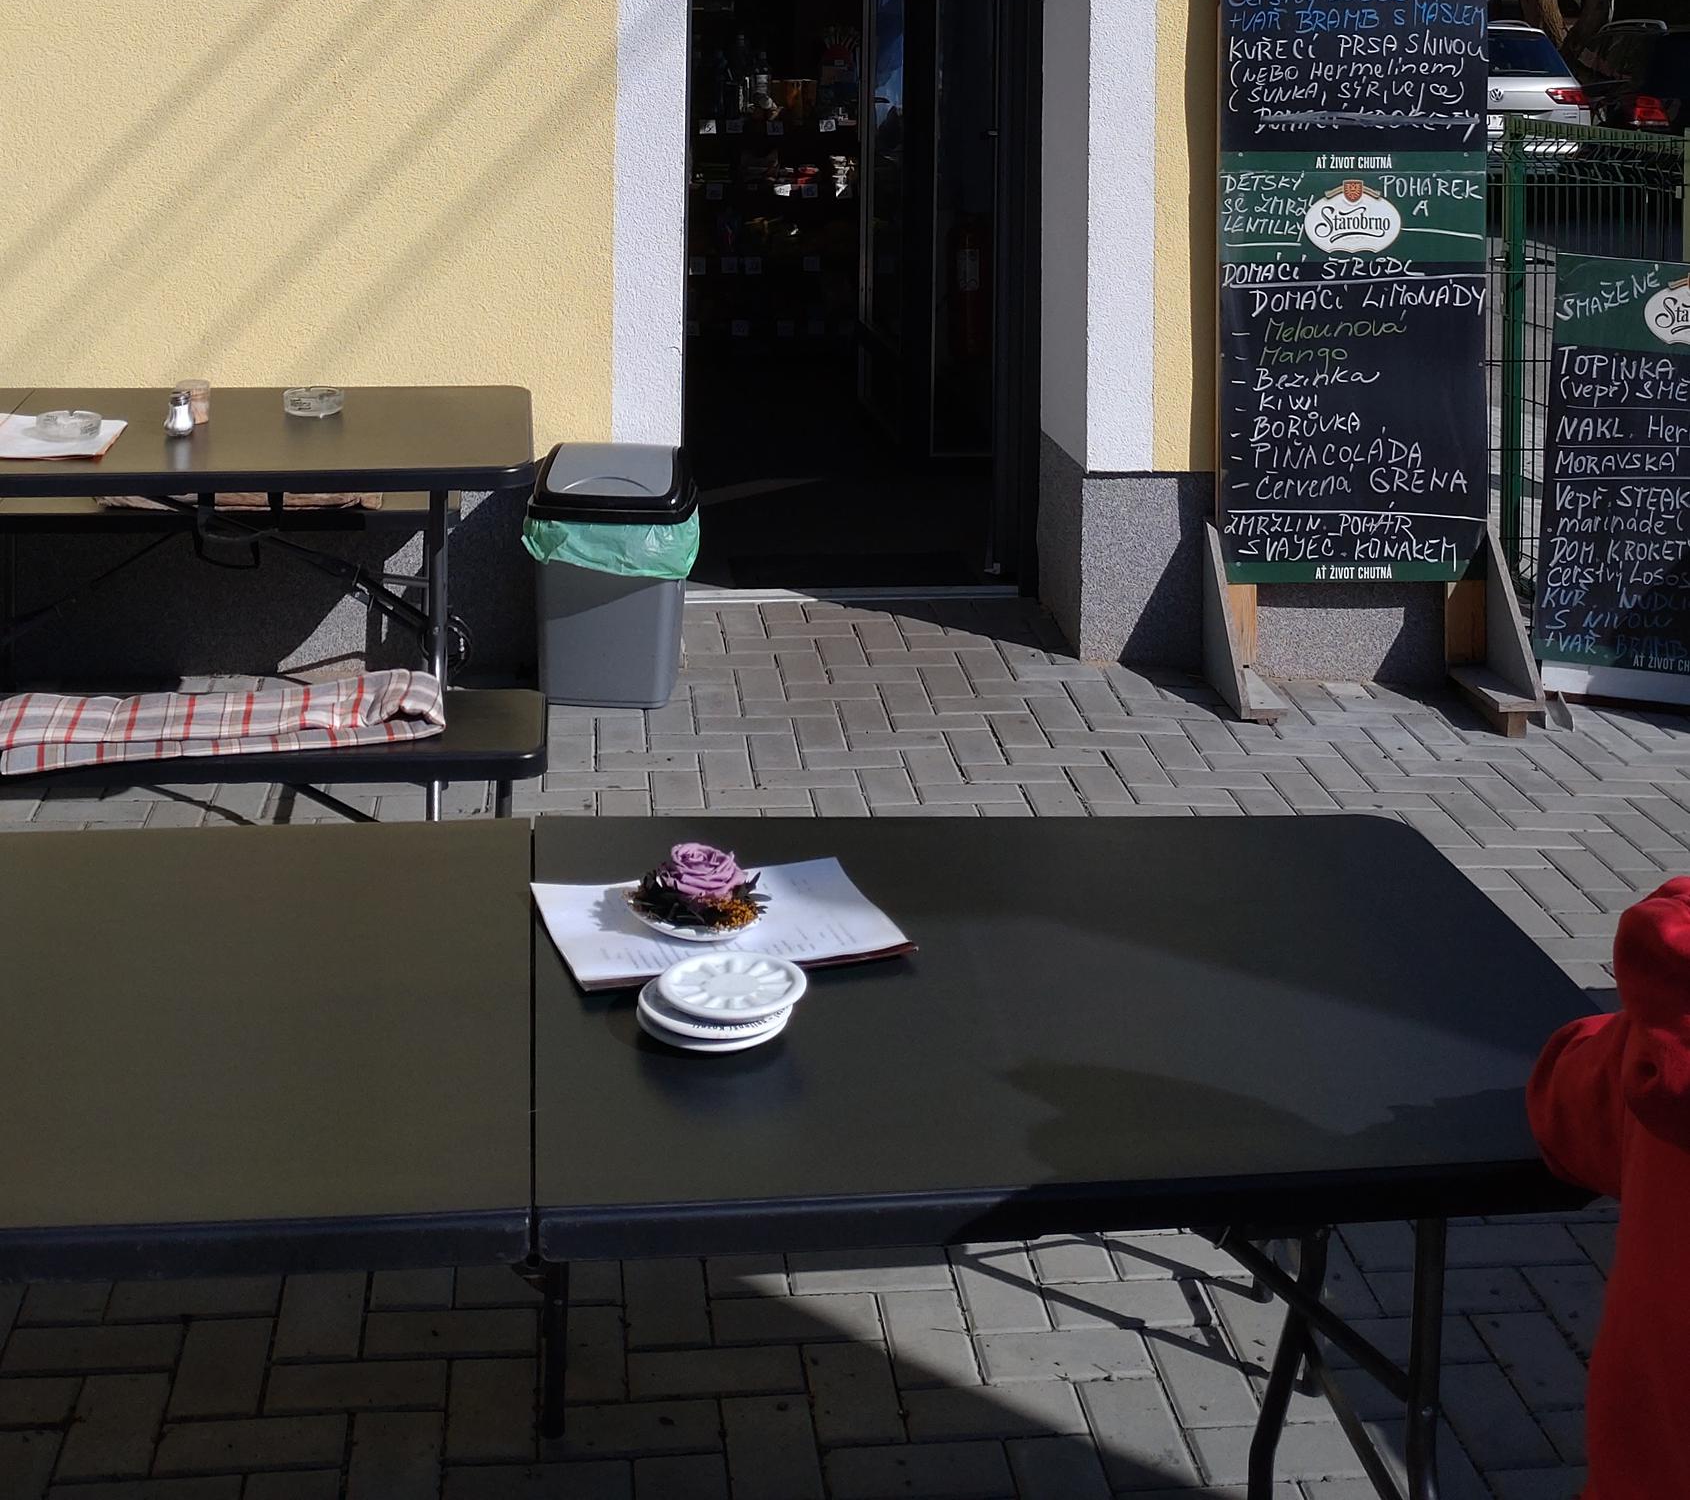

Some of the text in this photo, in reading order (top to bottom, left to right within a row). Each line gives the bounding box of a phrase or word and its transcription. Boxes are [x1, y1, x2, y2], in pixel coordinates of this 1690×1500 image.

[1337, 34, 1398, 58] PRSA
[1315, 153, 1393, 169] AŤ ŽIVOT CHUTNÁ
[1224, 215, 1304, 242] LENTILKY
[1314, 205, 1391, 242] Starobrno
[1259, 346, 1348, 373] Mango
[1558, 345, 1676, 381] TOPINKA
[1647, 414, 1690, 444] Her
[1607, 539, 1690, 564] KROKET
[1315, 564, 1393, 580] AŤ ŽIVOT CHUTNÁ
